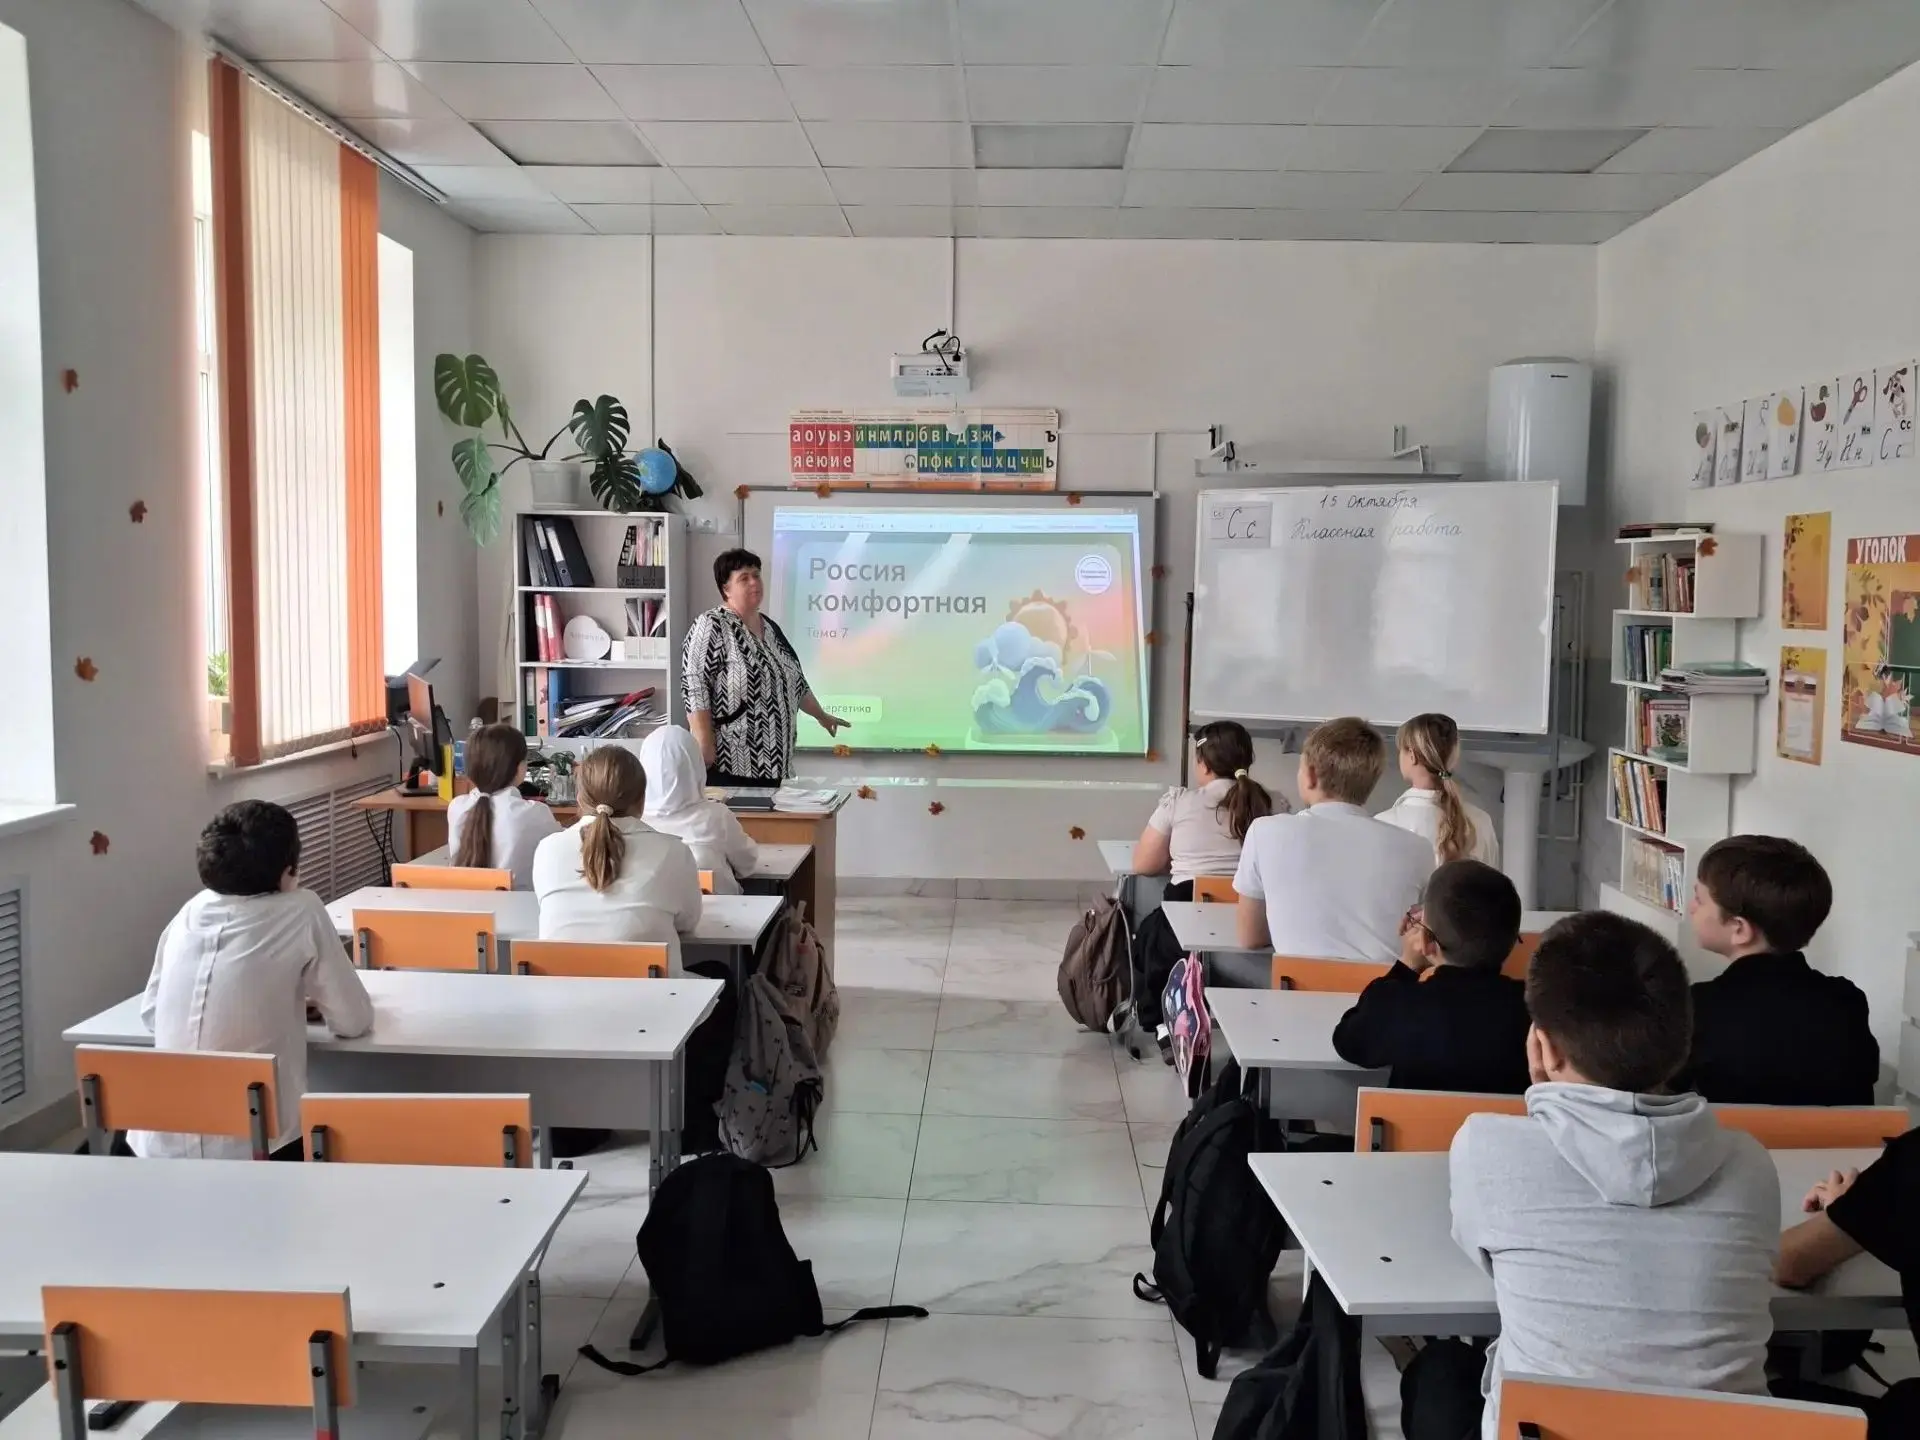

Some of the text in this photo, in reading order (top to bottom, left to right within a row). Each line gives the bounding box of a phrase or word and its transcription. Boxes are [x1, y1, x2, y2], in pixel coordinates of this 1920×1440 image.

[1320, 494, 1337, 508] 15
[1291, 515, 1463, 543] Классная работа
[1855, 536, 1907, 564] УГОЛОК
[809, 557, 906, 582] Россия
[807, 590, 987, 619] комфортная
[806, 626, 849, 639] Тема 7
[823, 705, 872, 715] ергетика
